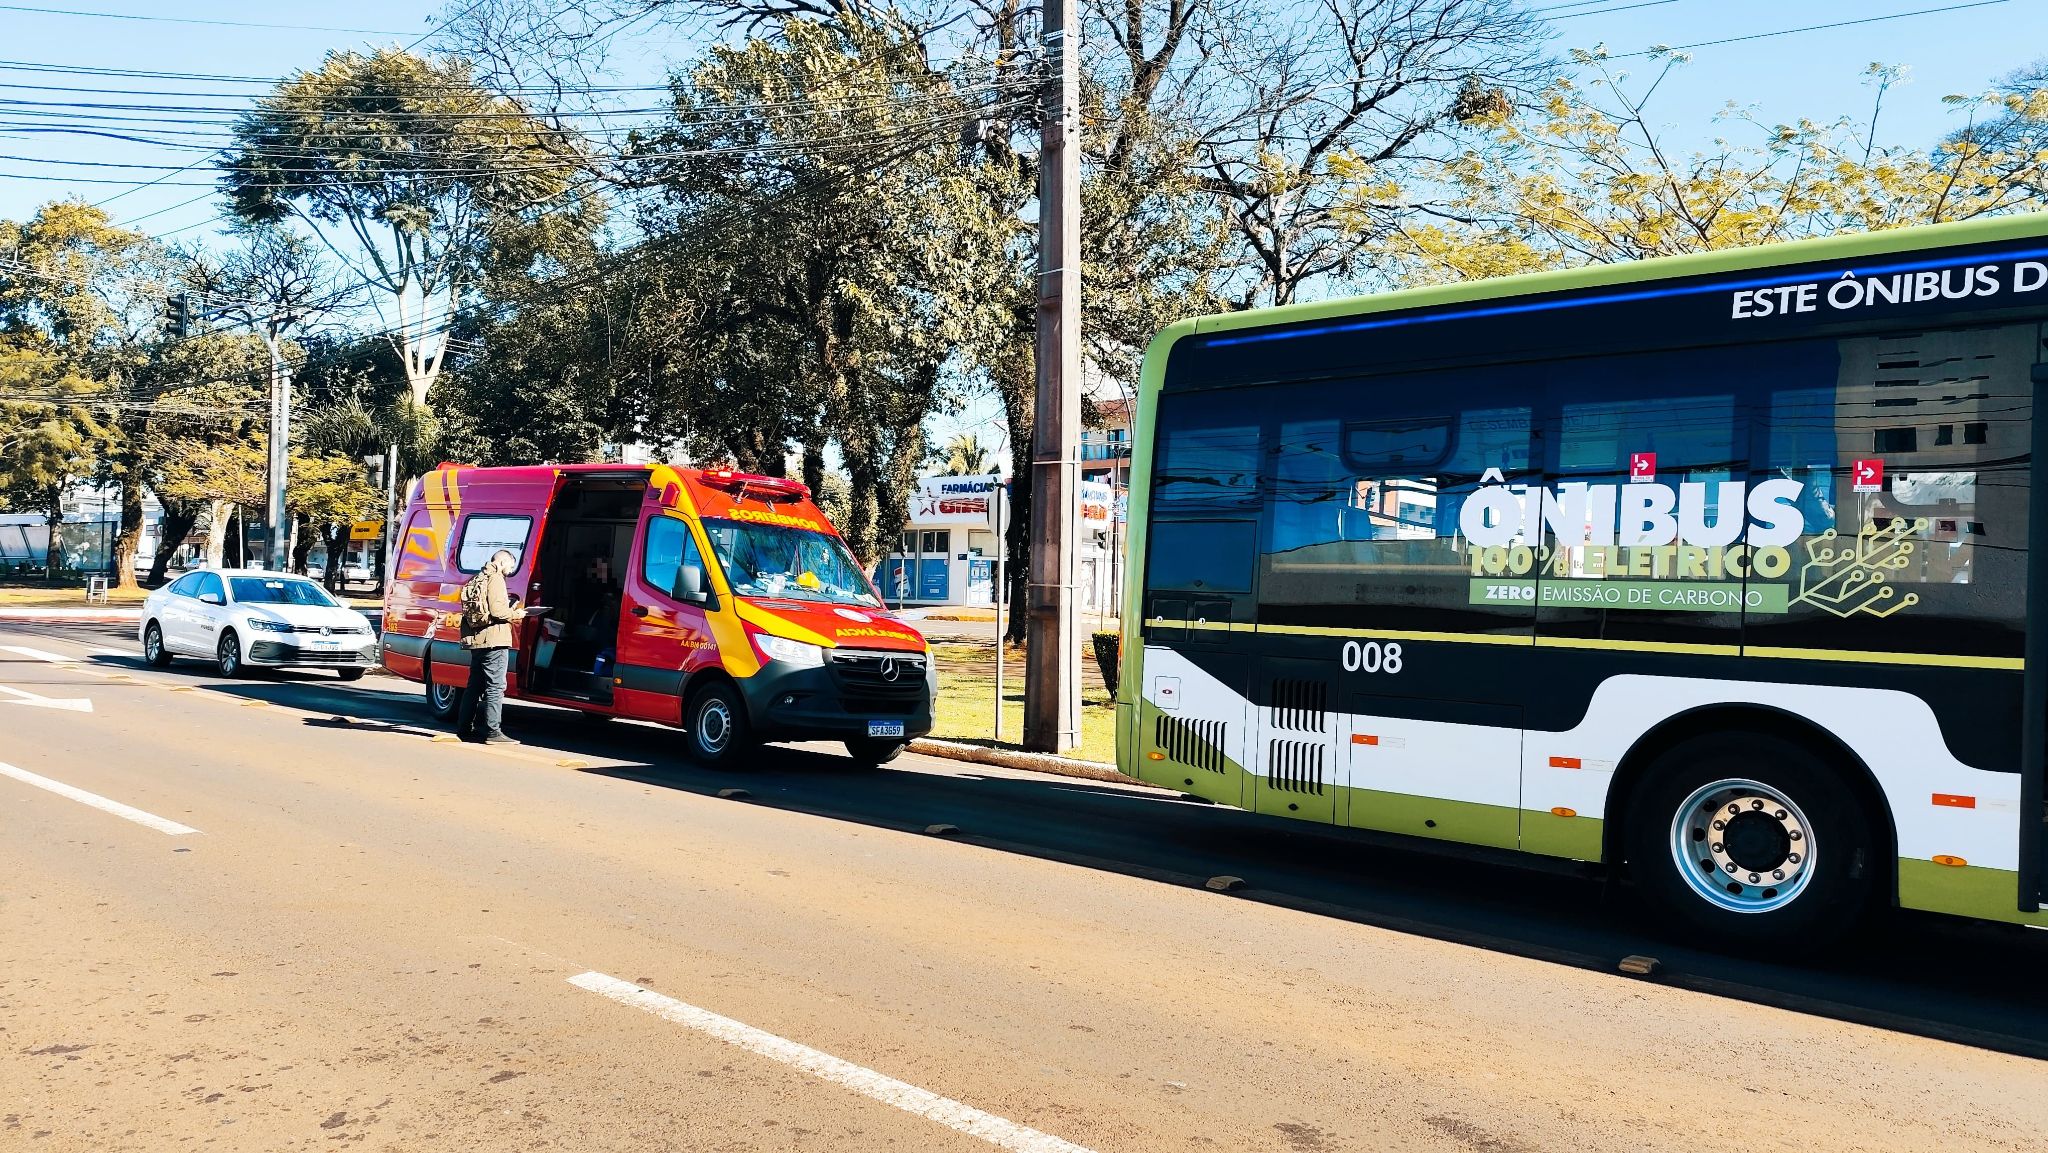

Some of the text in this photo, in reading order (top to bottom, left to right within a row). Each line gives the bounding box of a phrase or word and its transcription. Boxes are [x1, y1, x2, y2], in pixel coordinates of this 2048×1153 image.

[1732, 284, 1817, 319] ESTE
[1827, 265, 2000, 310] ÔNIBUS
[1459, 467, 1805, 549] ÔNIBUS
[1467, 534, 1791, 578] 100% ELÉTRICO
[1485, 584, 1762, 607] ZERO EMISSÃO DE CARBONO
[1342, 640, 1403, 674] 008
